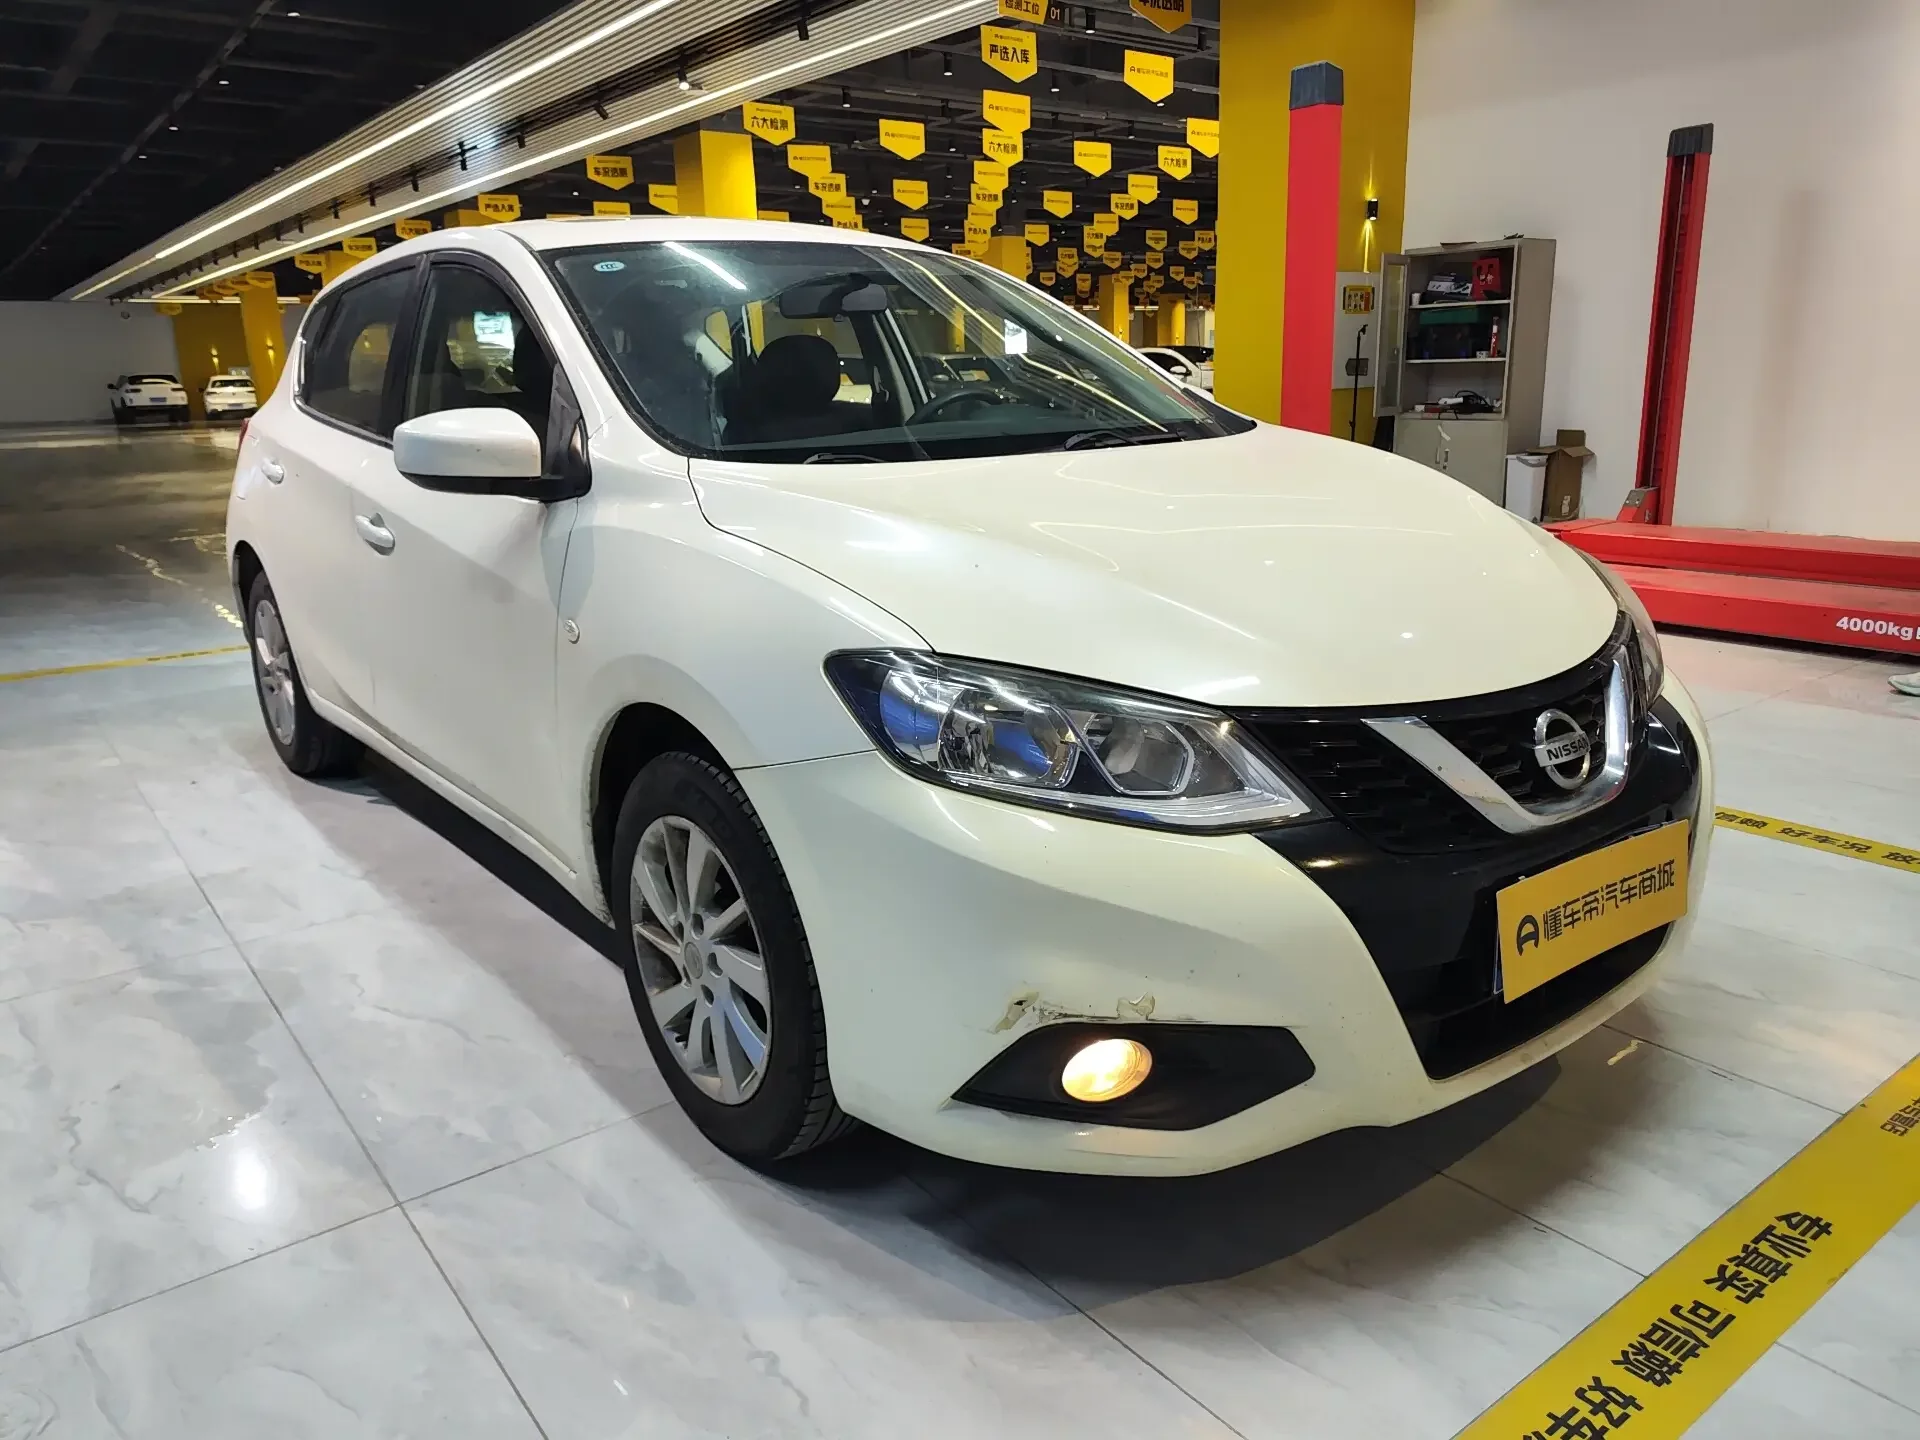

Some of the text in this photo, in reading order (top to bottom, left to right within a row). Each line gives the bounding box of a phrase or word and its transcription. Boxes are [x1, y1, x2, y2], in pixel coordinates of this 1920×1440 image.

[1050, 7, 1060, 20] 01
[988, 44, 1030, 64] 严选入库
[751, 115, 789, 131] 六大检测
[988, 141, 1018, 155] 六大检测
[1836, 616, 1913, 641] 4000kg
[1546, 736, 1589, 761] NISSAN
[1776, 826, 1873, 854] 好车况
[1881, 850, 1920, 866] 放
[1542, 858, 1675, 941] 懂车帝汽车商城
[1522, 1211, 1835, 1440] 专业真实 可信赖 好车
